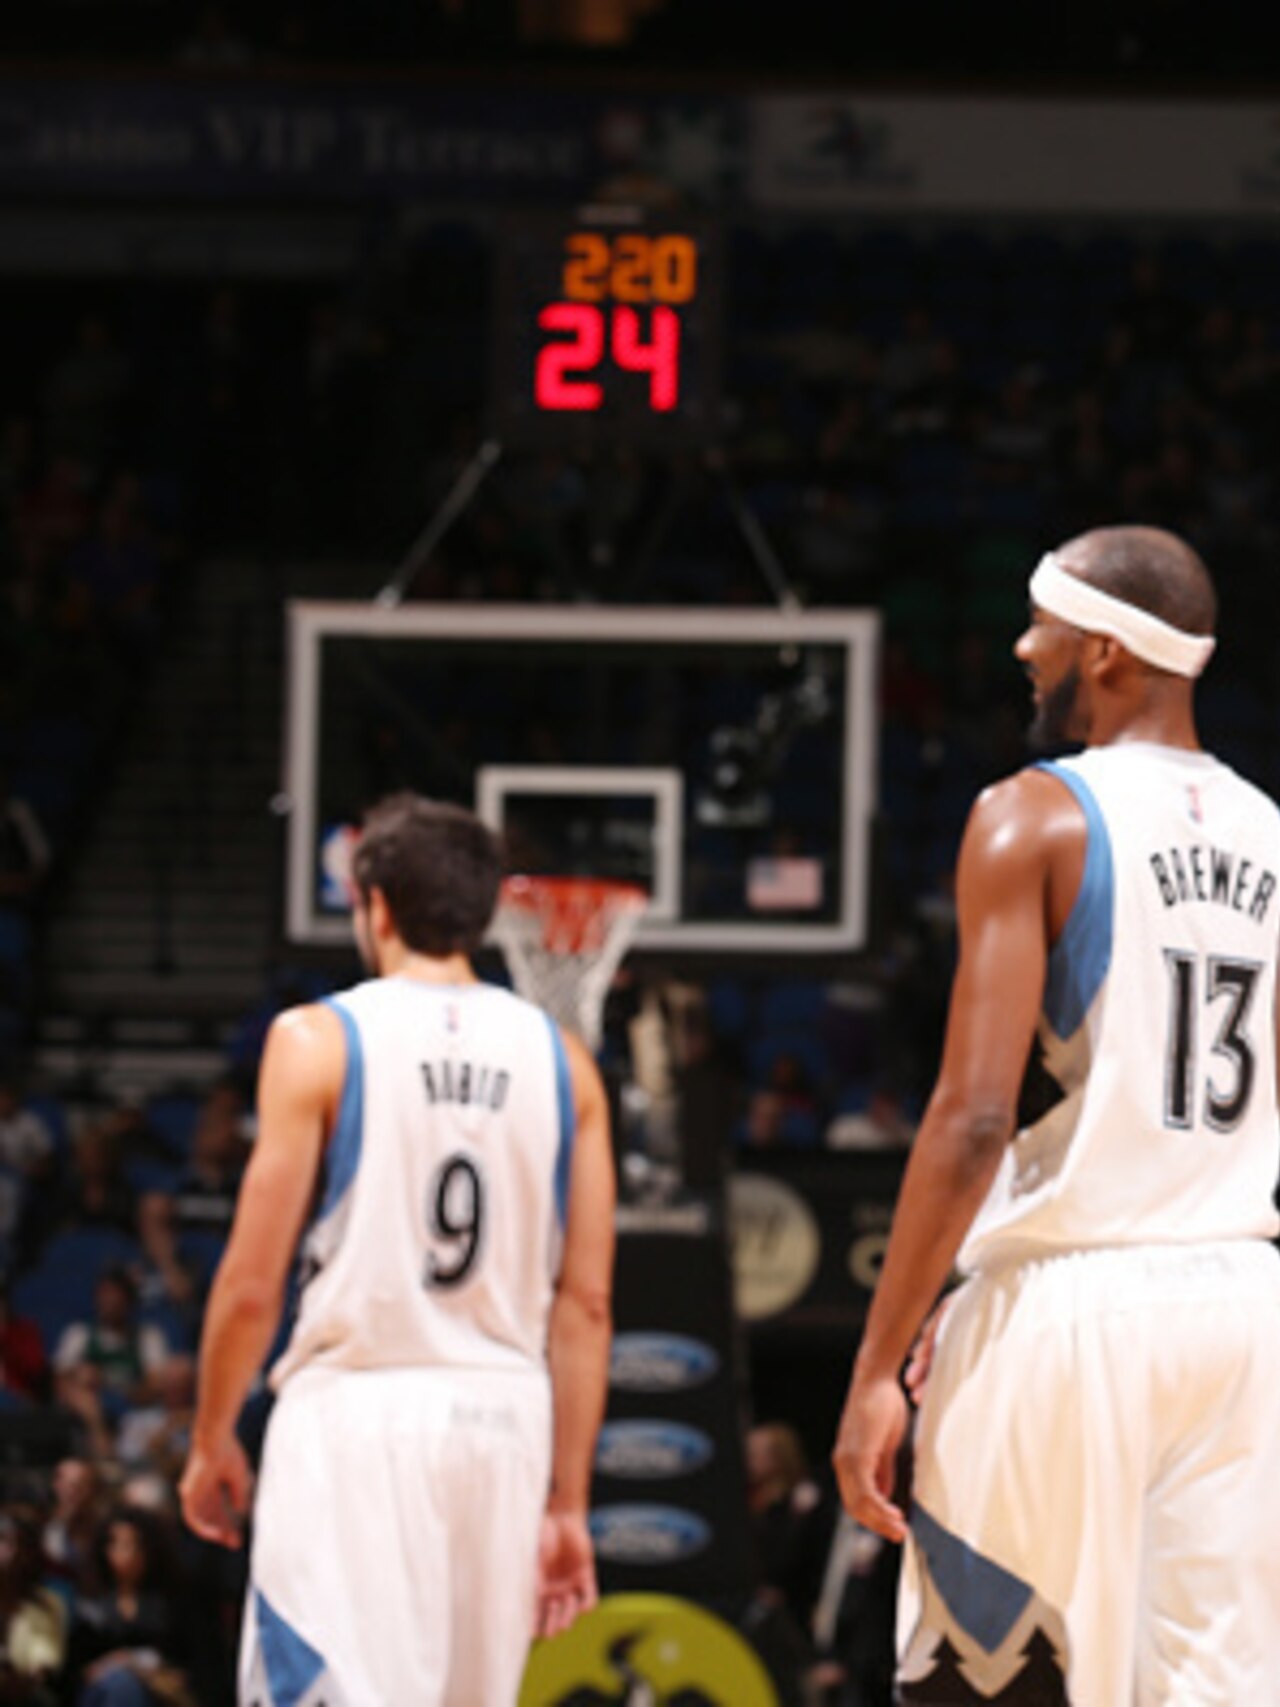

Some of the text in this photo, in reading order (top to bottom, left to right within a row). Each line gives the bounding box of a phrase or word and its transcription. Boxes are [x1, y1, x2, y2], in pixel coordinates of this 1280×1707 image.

[206, 105, 338, 173] VIP
[535, 302, 681, 413] 24
[1150, 847, 1277, 925] BREWER
[1162, 948, 1268, 1135] 13
[423, 1152, 488, 1291] 9
